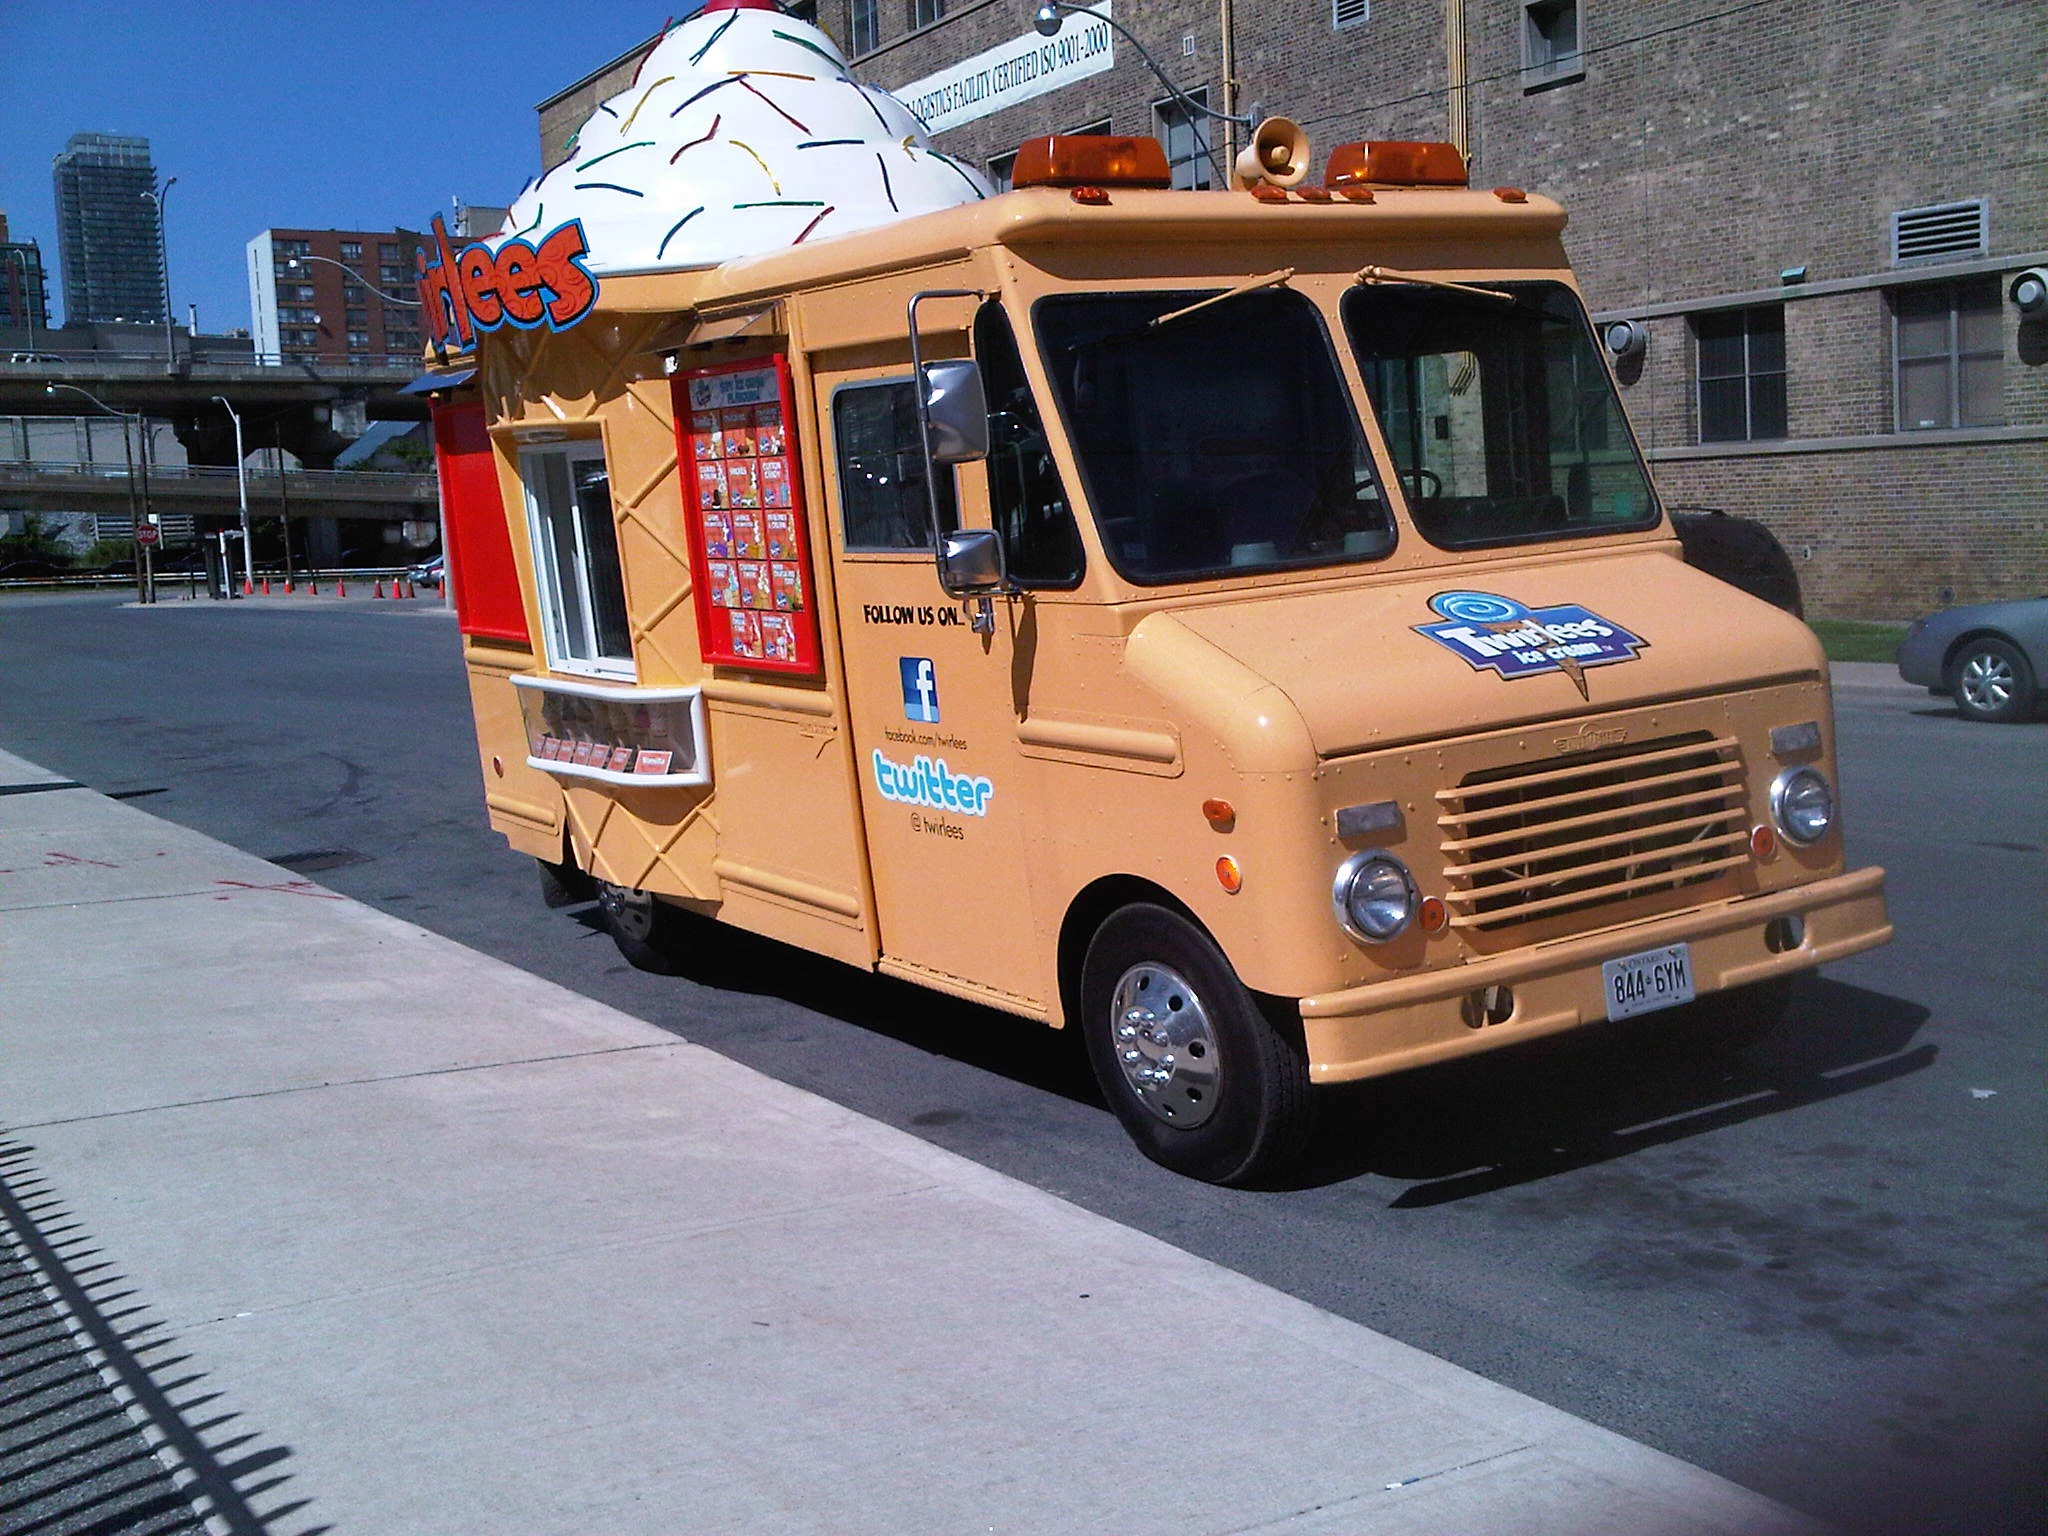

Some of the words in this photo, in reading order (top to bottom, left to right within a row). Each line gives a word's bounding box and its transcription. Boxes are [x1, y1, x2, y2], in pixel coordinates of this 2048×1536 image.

[953, 70, 991, 109] FACILITY
[992, 51, 1038, 94] CERTIFIED
[1040, 43, 1056, 76] ISO
[1059, 22, 1109, 68] 9001-2000
[138, 530, 157, 538] STOP
[863, 604, 914, 625] FOLLOW
[918, 605, 935, 625] US
[1434, 618, 1614, 657] Twirlees
[1512, 650, 1546, 664] ice
[1546, 643, 1603, 661] cream
[872, 748, 993, 817] twitter
[923, 816, 965, 840] twirlees
[1614, 969, 1646, 1004] 844
[1654, 959, 1687, 993] 6YM
